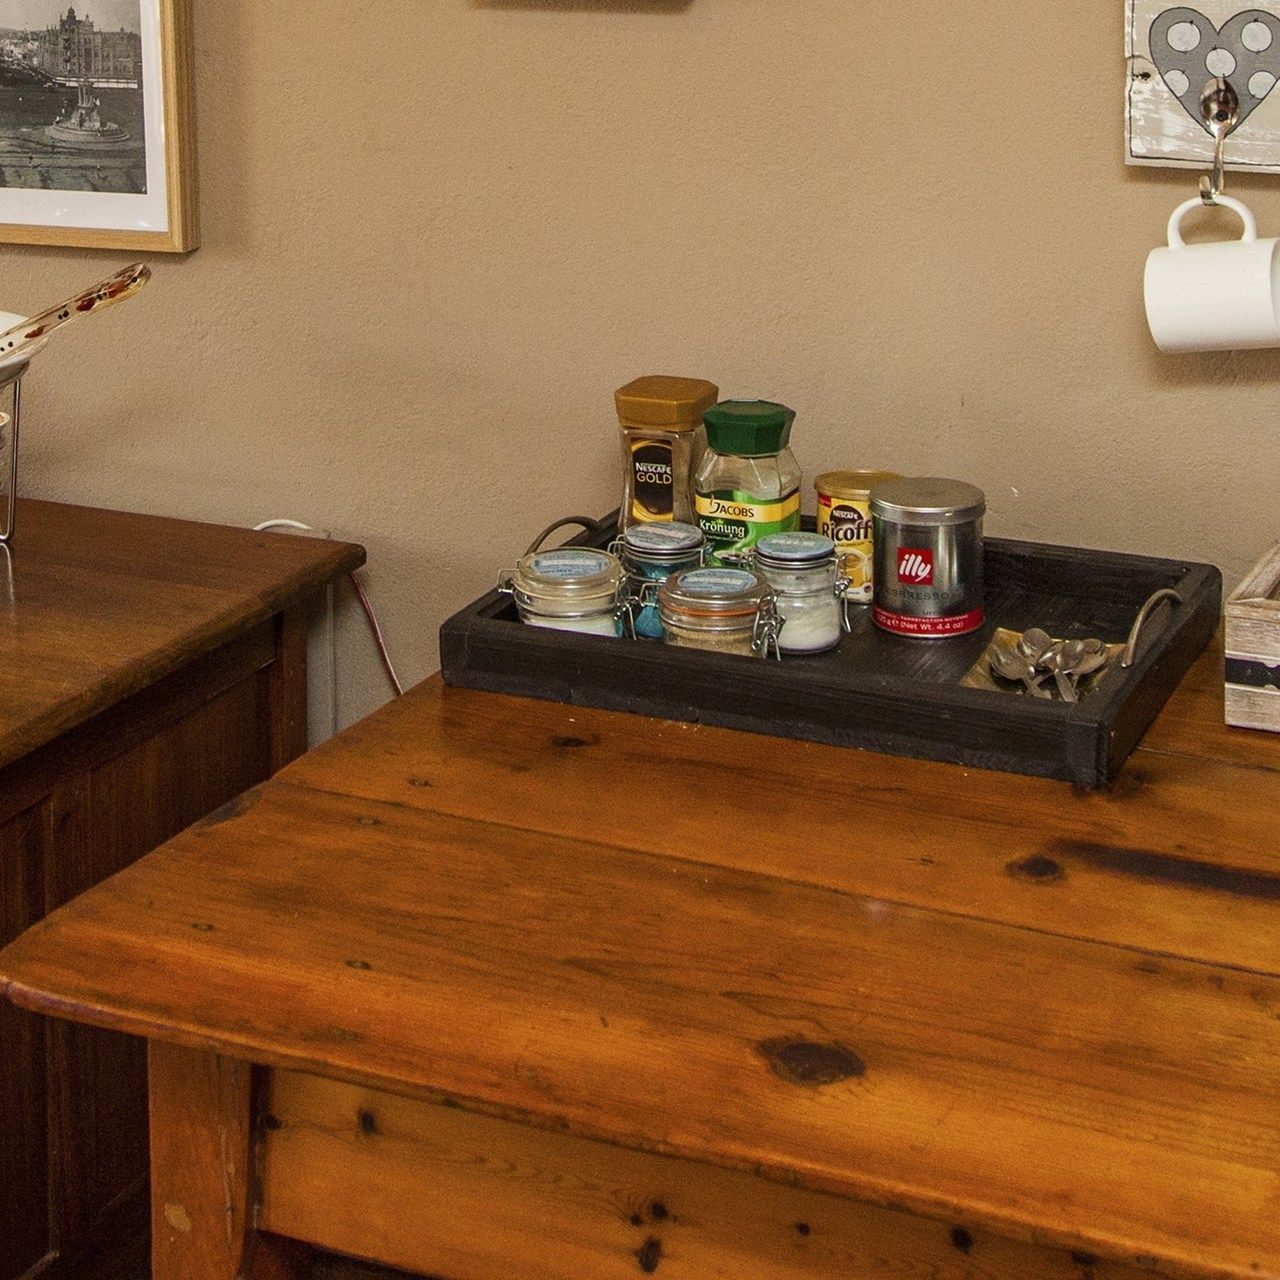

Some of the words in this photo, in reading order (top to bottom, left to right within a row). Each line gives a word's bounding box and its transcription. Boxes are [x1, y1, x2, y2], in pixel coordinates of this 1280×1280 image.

[636, 472, 672, 485] GOLD
[709, 494, 755, 518] JACOBS
[699, 519, 745, 539] Krönung
[822, 519, 873, 542] Ricoff
[899, 553, 932, 582] illy
